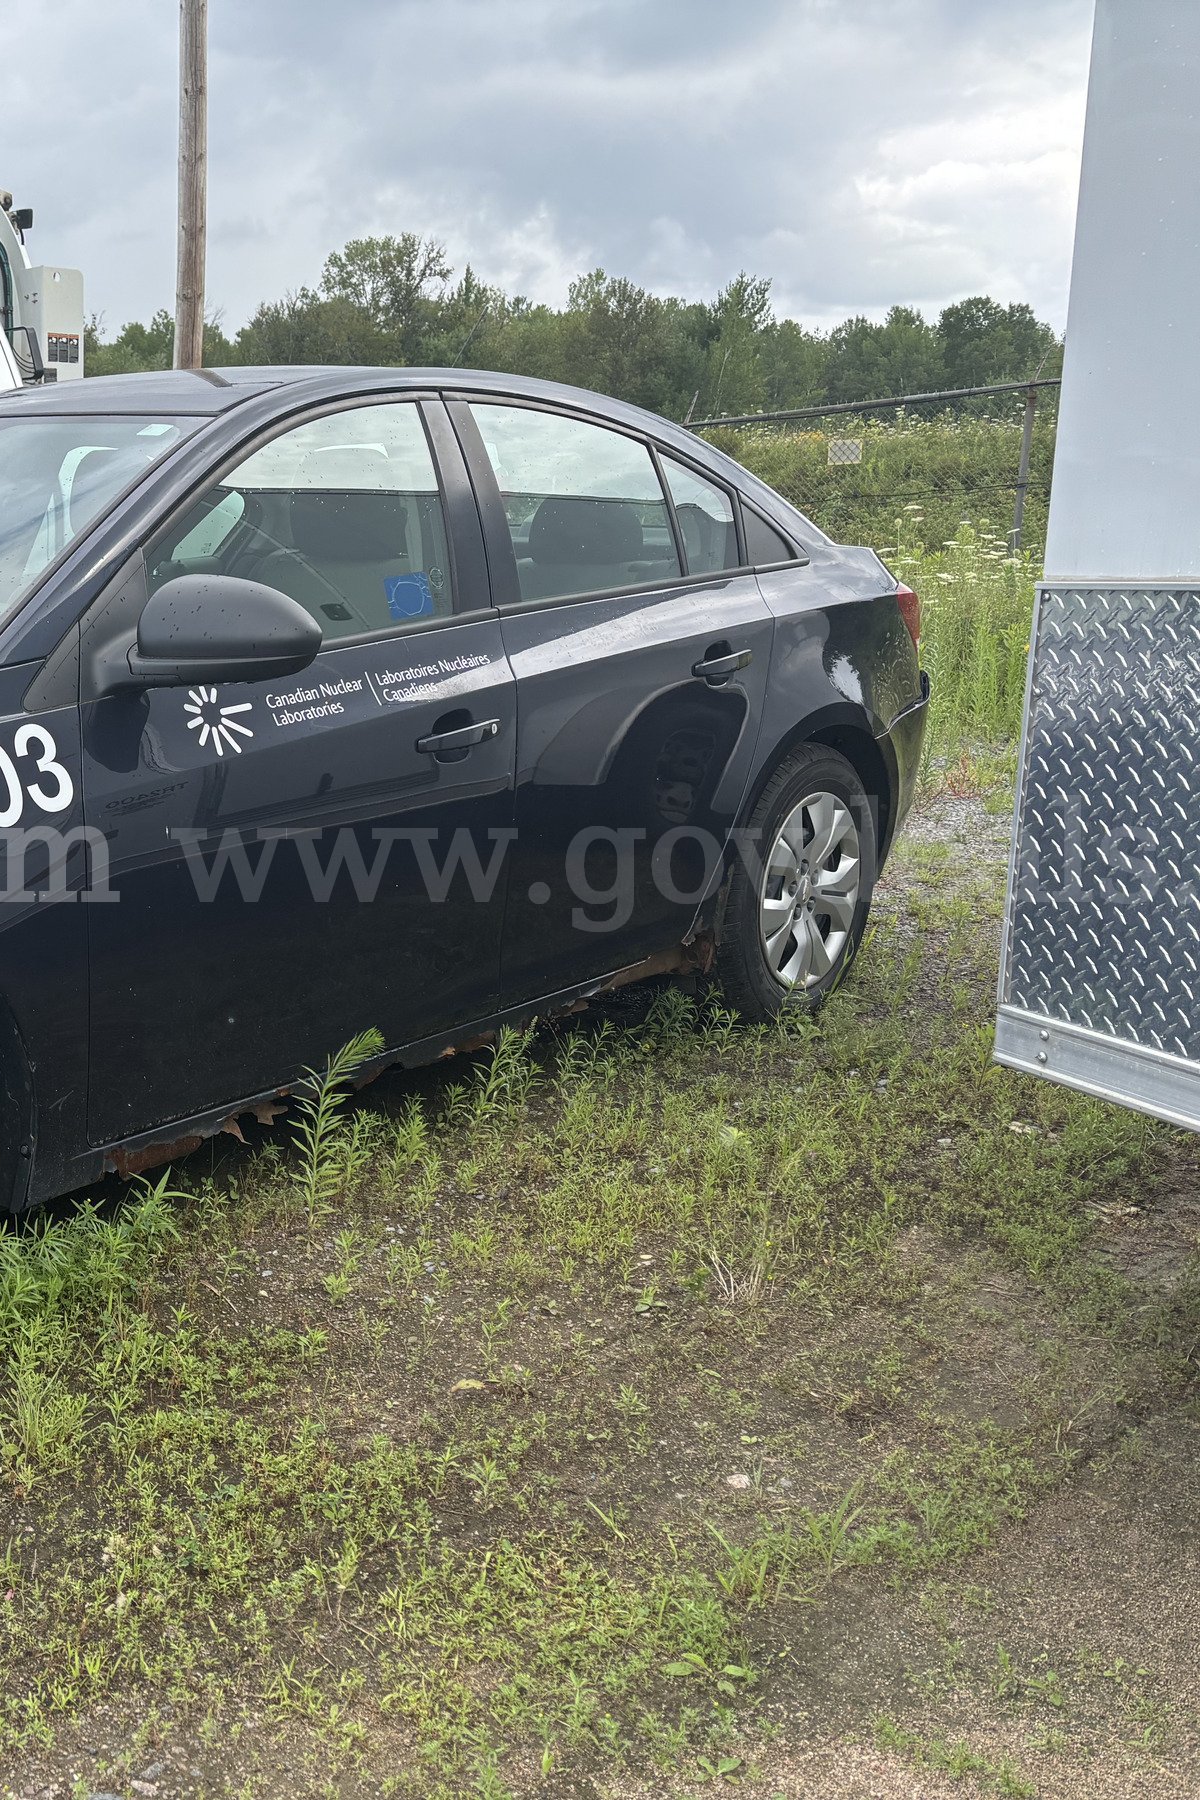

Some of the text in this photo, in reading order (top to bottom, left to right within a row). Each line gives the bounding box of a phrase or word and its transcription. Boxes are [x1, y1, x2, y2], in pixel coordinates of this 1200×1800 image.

[375, 653, 491, 686] Laboratoires Nucléaires
[265, 678, 363, 709] Canadian Nuclear
[382, 681, 438, 703] Canadiens
[272, 701, 345, 727] Laboratories
